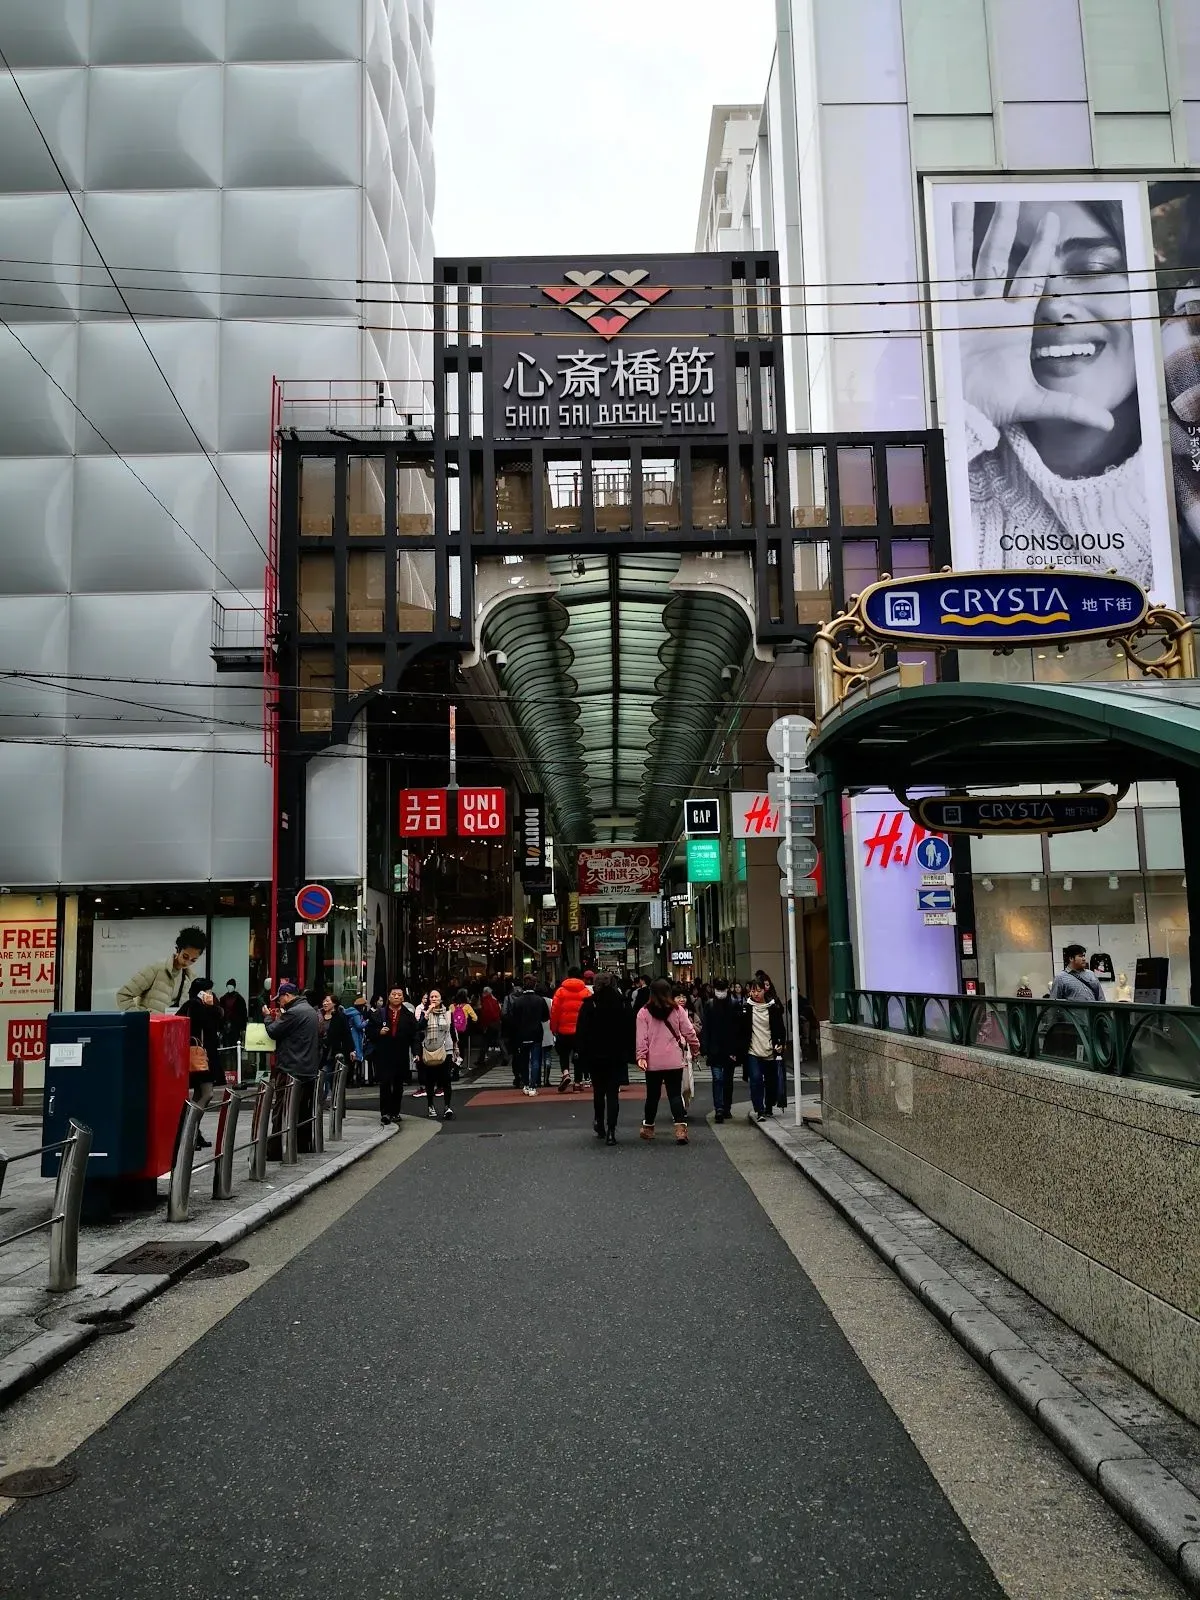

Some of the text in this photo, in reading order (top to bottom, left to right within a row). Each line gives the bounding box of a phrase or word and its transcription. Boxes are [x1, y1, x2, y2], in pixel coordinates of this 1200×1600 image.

[503, 347, 716, 398] 心斎橋筋
[506, 405, 550, 427] SHIN
[559, 404, 590, 426] SAI
[1000, 533, 1125, 551] CONSCIOUS
[1026, 555, 1101, 565] COLLECTION
[939, 587, 1132, 613] CRYSTA 地下街
[407, 795, 441, 811] ユニ
[463, 794, 497, 811] UNI
[978, 802, 1054, 818] CRYSTA
[405, 815, 441, 831] クロ
[463, 813, 500, 832] QLO
[693, 809, 711, 824] GAP
[744, 796, 779, 834] H&
[3, 928, 56, 949] FREE
[17, 951, 31, 960] TAX
[12, 1024, 42, 1039] UNI
[12, 1041, 44, 1058] QLO
